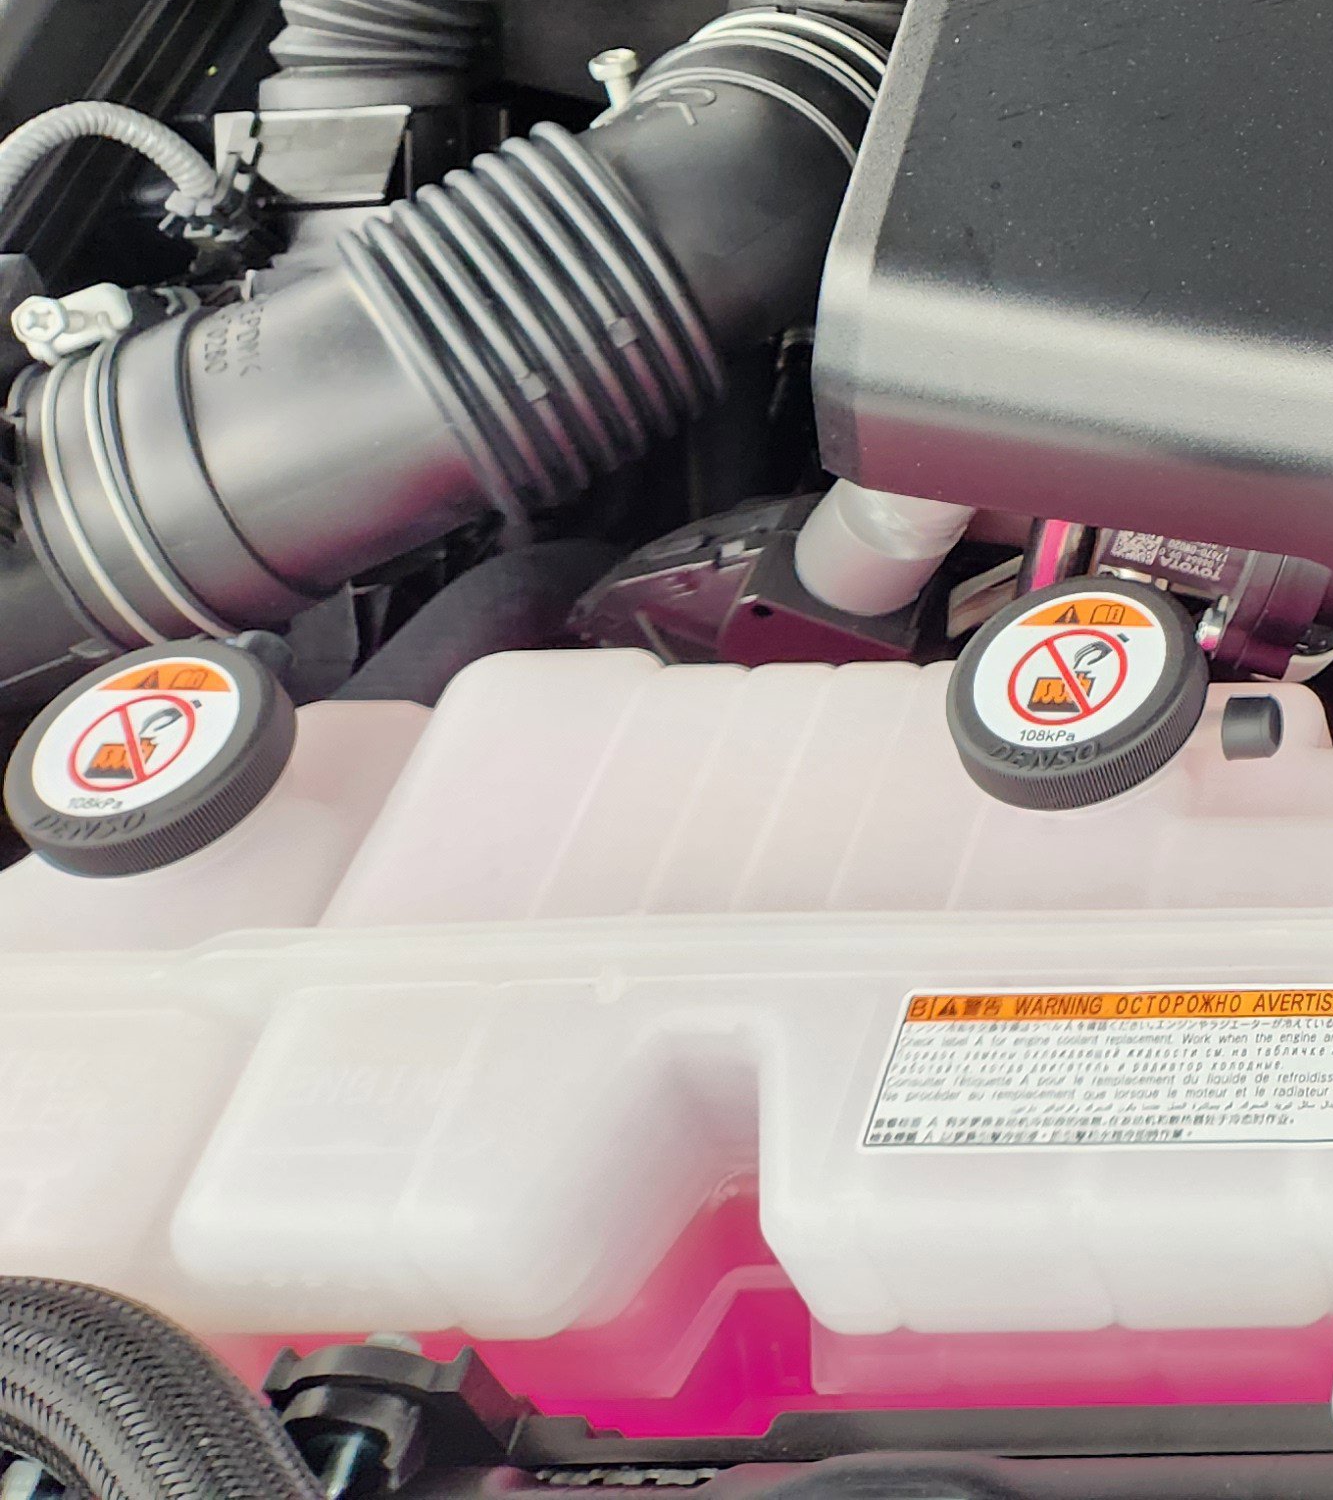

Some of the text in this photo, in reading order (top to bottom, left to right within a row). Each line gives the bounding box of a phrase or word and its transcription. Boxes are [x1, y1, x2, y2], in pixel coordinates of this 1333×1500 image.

[1160, 555, 1222, 582] TOYOTA
[1019, 728, 1076, 743] 108kPa
[988, 740, 1100, 771] DENSO
[67, 797, 124, 810] 108kPa
[31, 811, 147, 841] DENSO
[909, 998, 931, 1017] B
[1012, 995, 1104, 1015] WARNING
[1114, 993, 1243, 1014] ОСТОРОЖНО
[1181, 1033, 1212, 1043] Work
[1217, 1032, 1248, 1043] when
[1254, 1032, 1273, 1042] the
[1278, 1032, 1317, 1044] engine
[1182, 1073, 1199, 1083] du
[1207, 1072, 1246, 1085] liquide
[1254, 1072, 1270, 1083] de
[1184, 1088, 1228, 1098] moteur
[1234, 1087, 1247, 1097] et
[1253, 1086, 1266, 1097] le
[1272, 1085, 1329, 1097] radiateur
